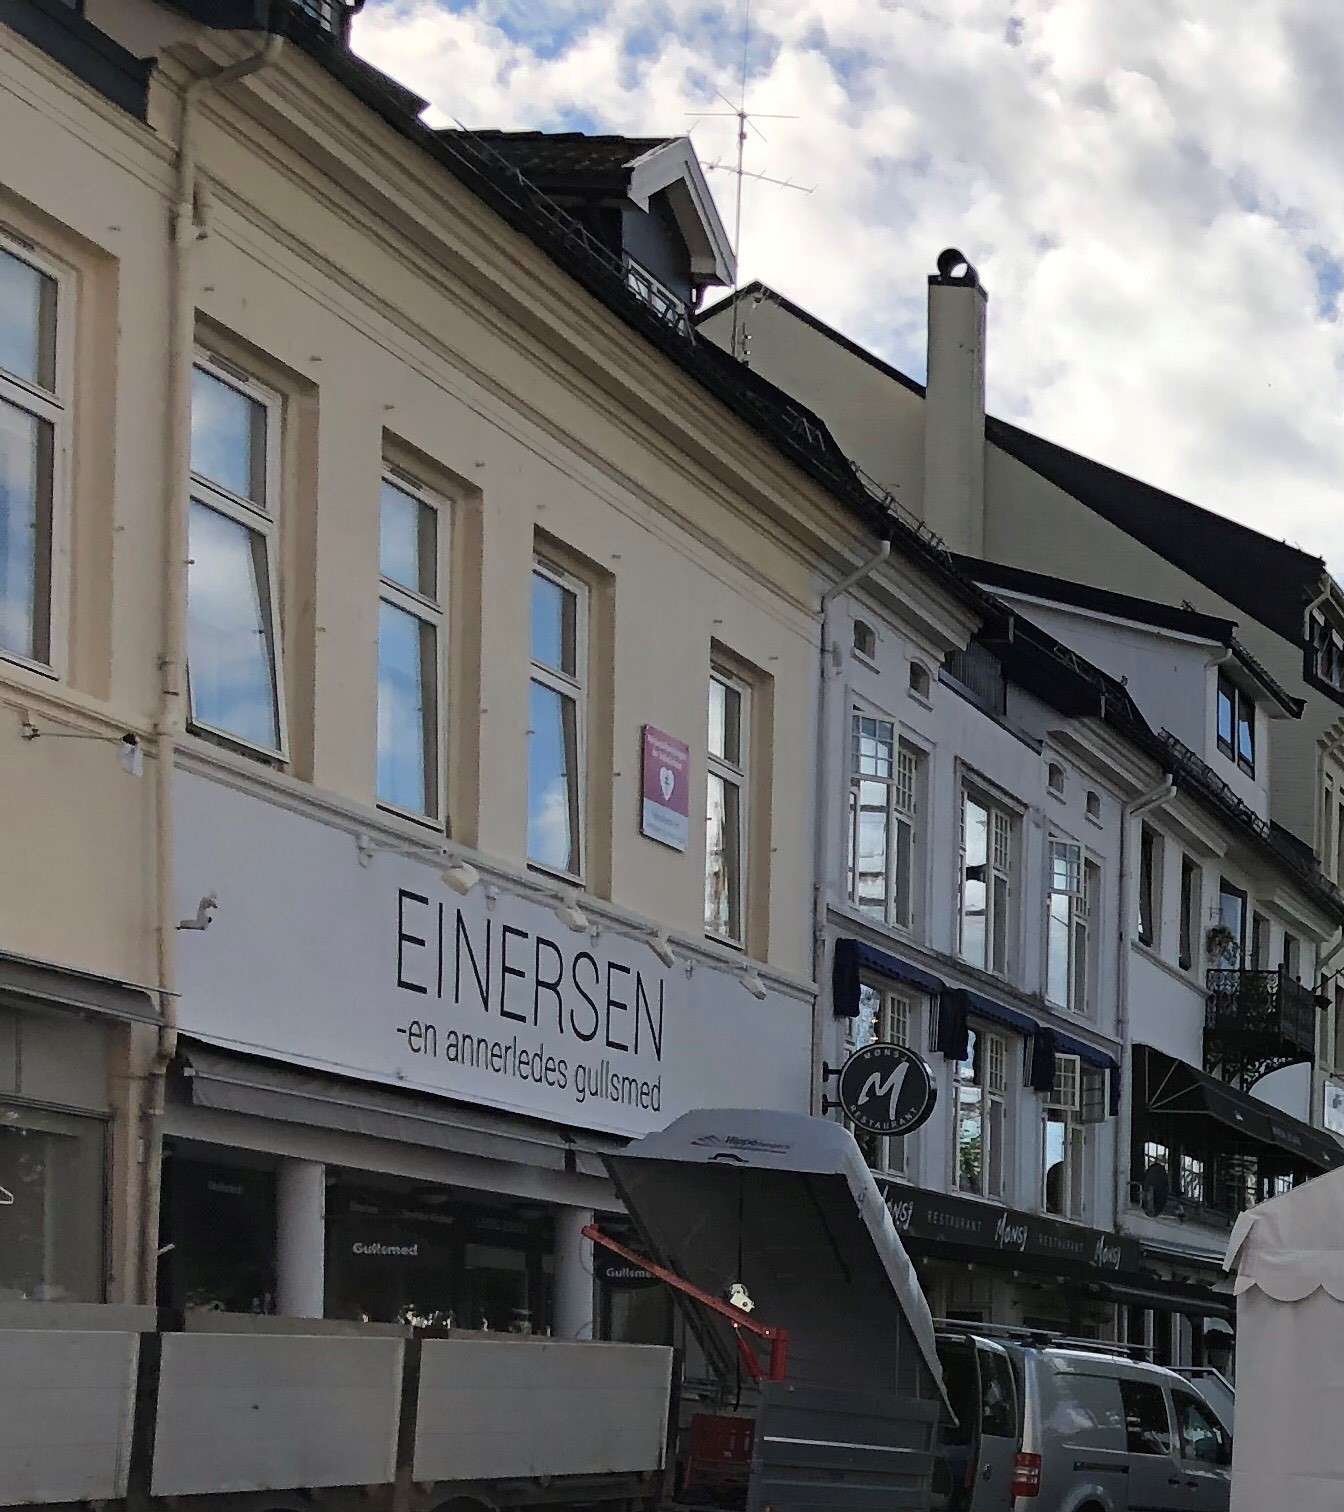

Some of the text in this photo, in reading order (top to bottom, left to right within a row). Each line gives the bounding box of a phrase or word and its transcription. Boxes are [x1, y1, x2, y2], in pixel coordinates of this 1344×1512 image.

[397, 887, 664, 1062] EINERSEN
[396, 1019, 662, 1113] -en annerledes gullsmed
[850, 1104, 918, 1130] RESTAURANT
[927, 1209, 982, 1233] RESTAURANT
[352, 1242, 418, 1257] Gullsmed
